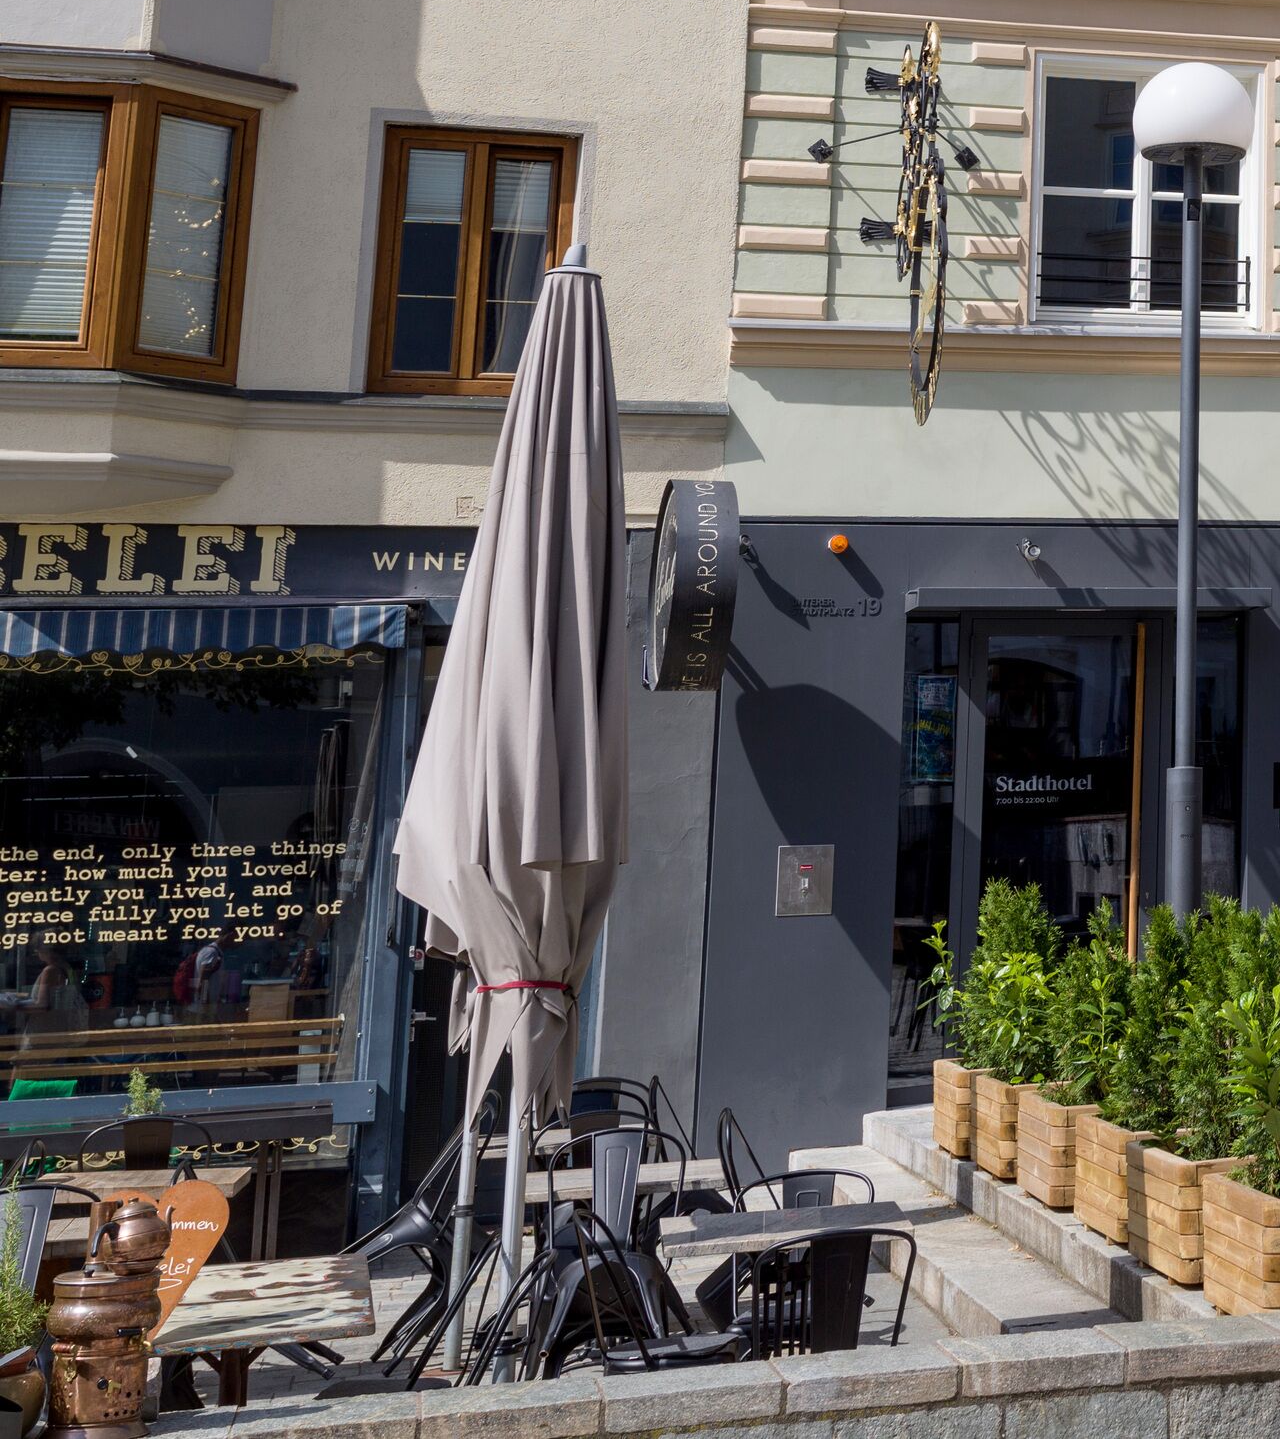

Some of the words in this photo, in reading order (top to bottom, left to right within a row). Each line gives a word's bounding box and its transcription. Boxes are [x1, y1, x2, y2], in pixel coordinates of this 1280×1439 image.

[0, 524, 296, 595] ELEI
[696, 503, 718, 596] AROUND
[858, 597, 882, 617] 19
[691, 607, 714, 643] ALL
[686, 652, 707, 667] IS
[995, 774, 1093, 792] Stadthotel
[1013, 796, 1024, 804] bis
[0, 846, 39, 862] the
[53, 845, 105, 862] end,
[121, 844, 176, 862] only
[191, 842, 256, 858] three
[271, 840, 347, 859] things
[64, 865, 106, 881] how
[119, 864, 173, 879] much
[187, 866, 228, 882] you
[241, 862, 318, 879] loved,
[6, 887, 90, 906] gently
[103, 888, 145, 904] you
[159, 883, 237, 901] lived,
[252, 881, 293, 897] and
[4, 910, 74, 928] grace
[88, 905, 156, 923] fully
[169, 906, 210, 922] you
[225, 903, 264, 918] let
[276, 904, 303, 920] go
[316, 900, 343, 915] of
[0, 931, 29, 949] gs
[43, 928, 86, 943] not
[98, 926, 168, 942] meant
[182, 924, 222, 940] for
[234, 925, 285, 942] you.
[171, 1219, 219, 1232] mmen
[156, 1257, 196, 1276] elei
